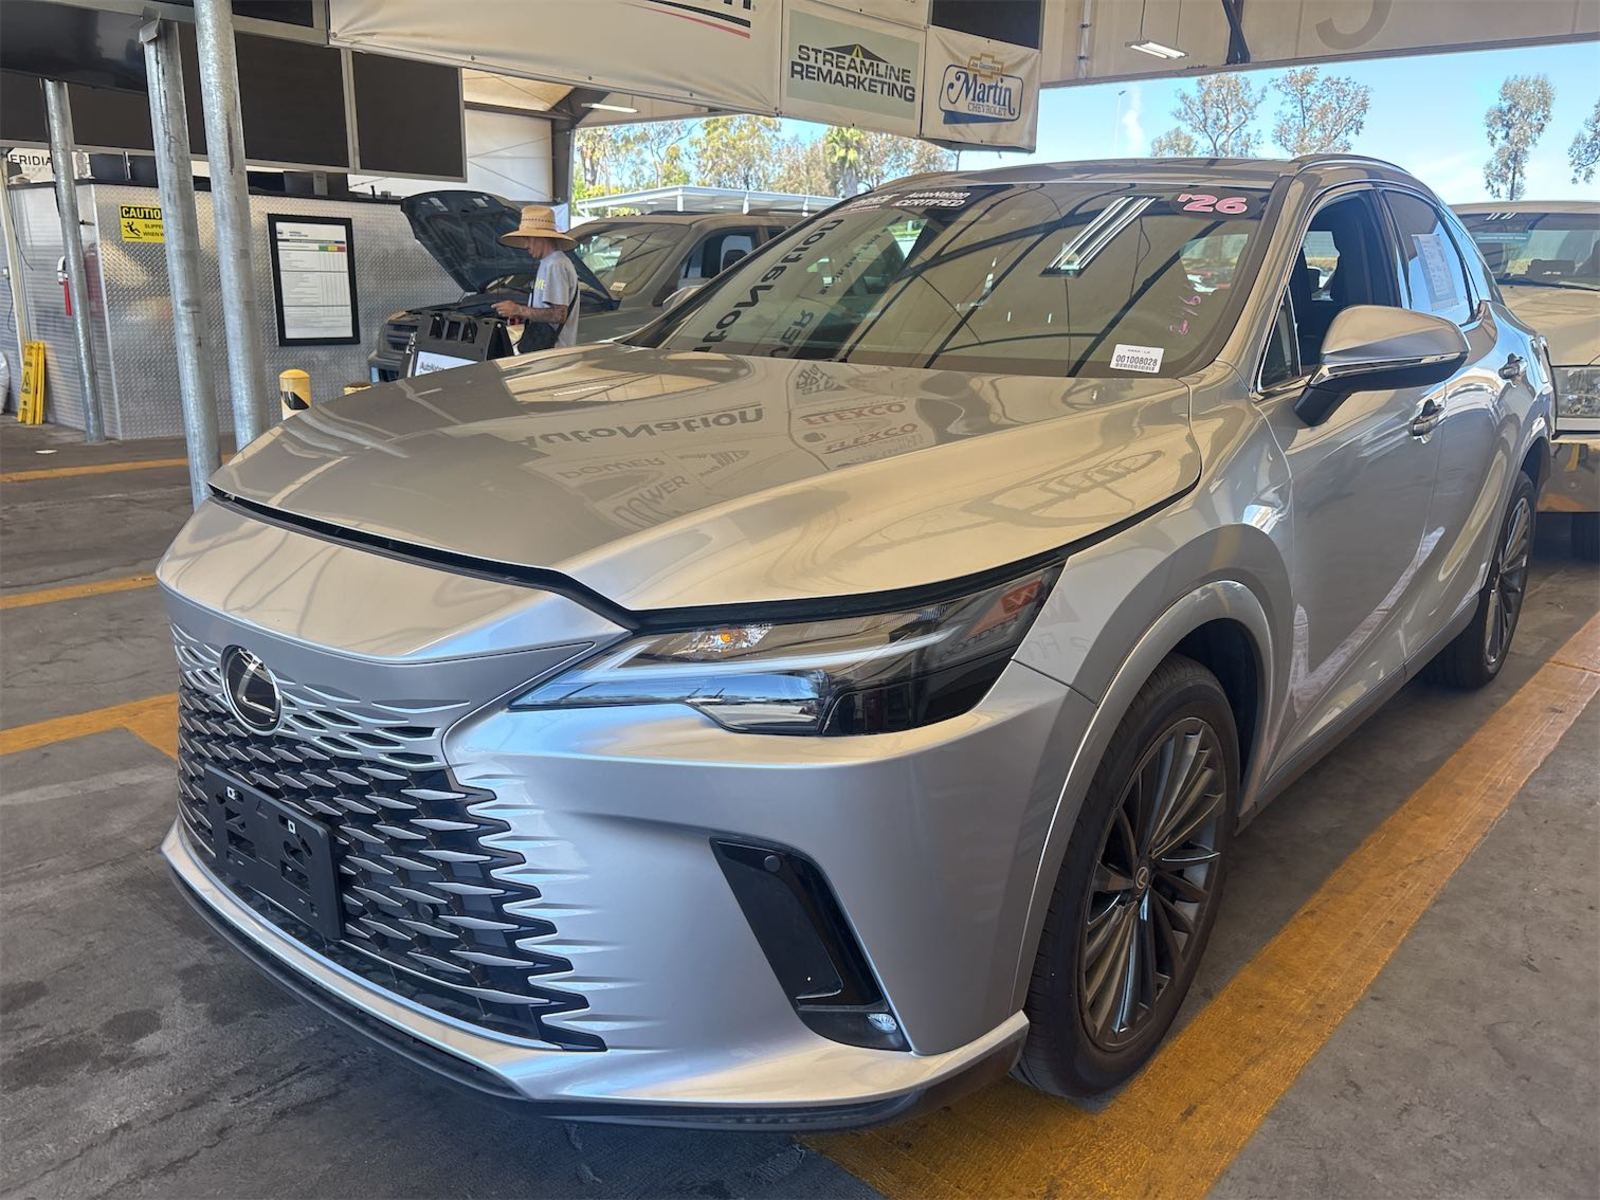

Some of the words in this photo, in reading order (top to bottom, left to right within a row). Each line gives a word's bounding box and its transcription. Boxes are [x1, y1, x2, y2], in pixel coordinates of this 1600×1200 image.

[798, 45, 912, 84] STREAMLINE
[790, 61, 916, 102] REMARKETING
[947, 71, 1016, 116] Martin
[10, 154, 53, 166] ERIDIA
[122, 207, 162, 219] CAUTIO
[1177, 193, 1248, 215] '26
